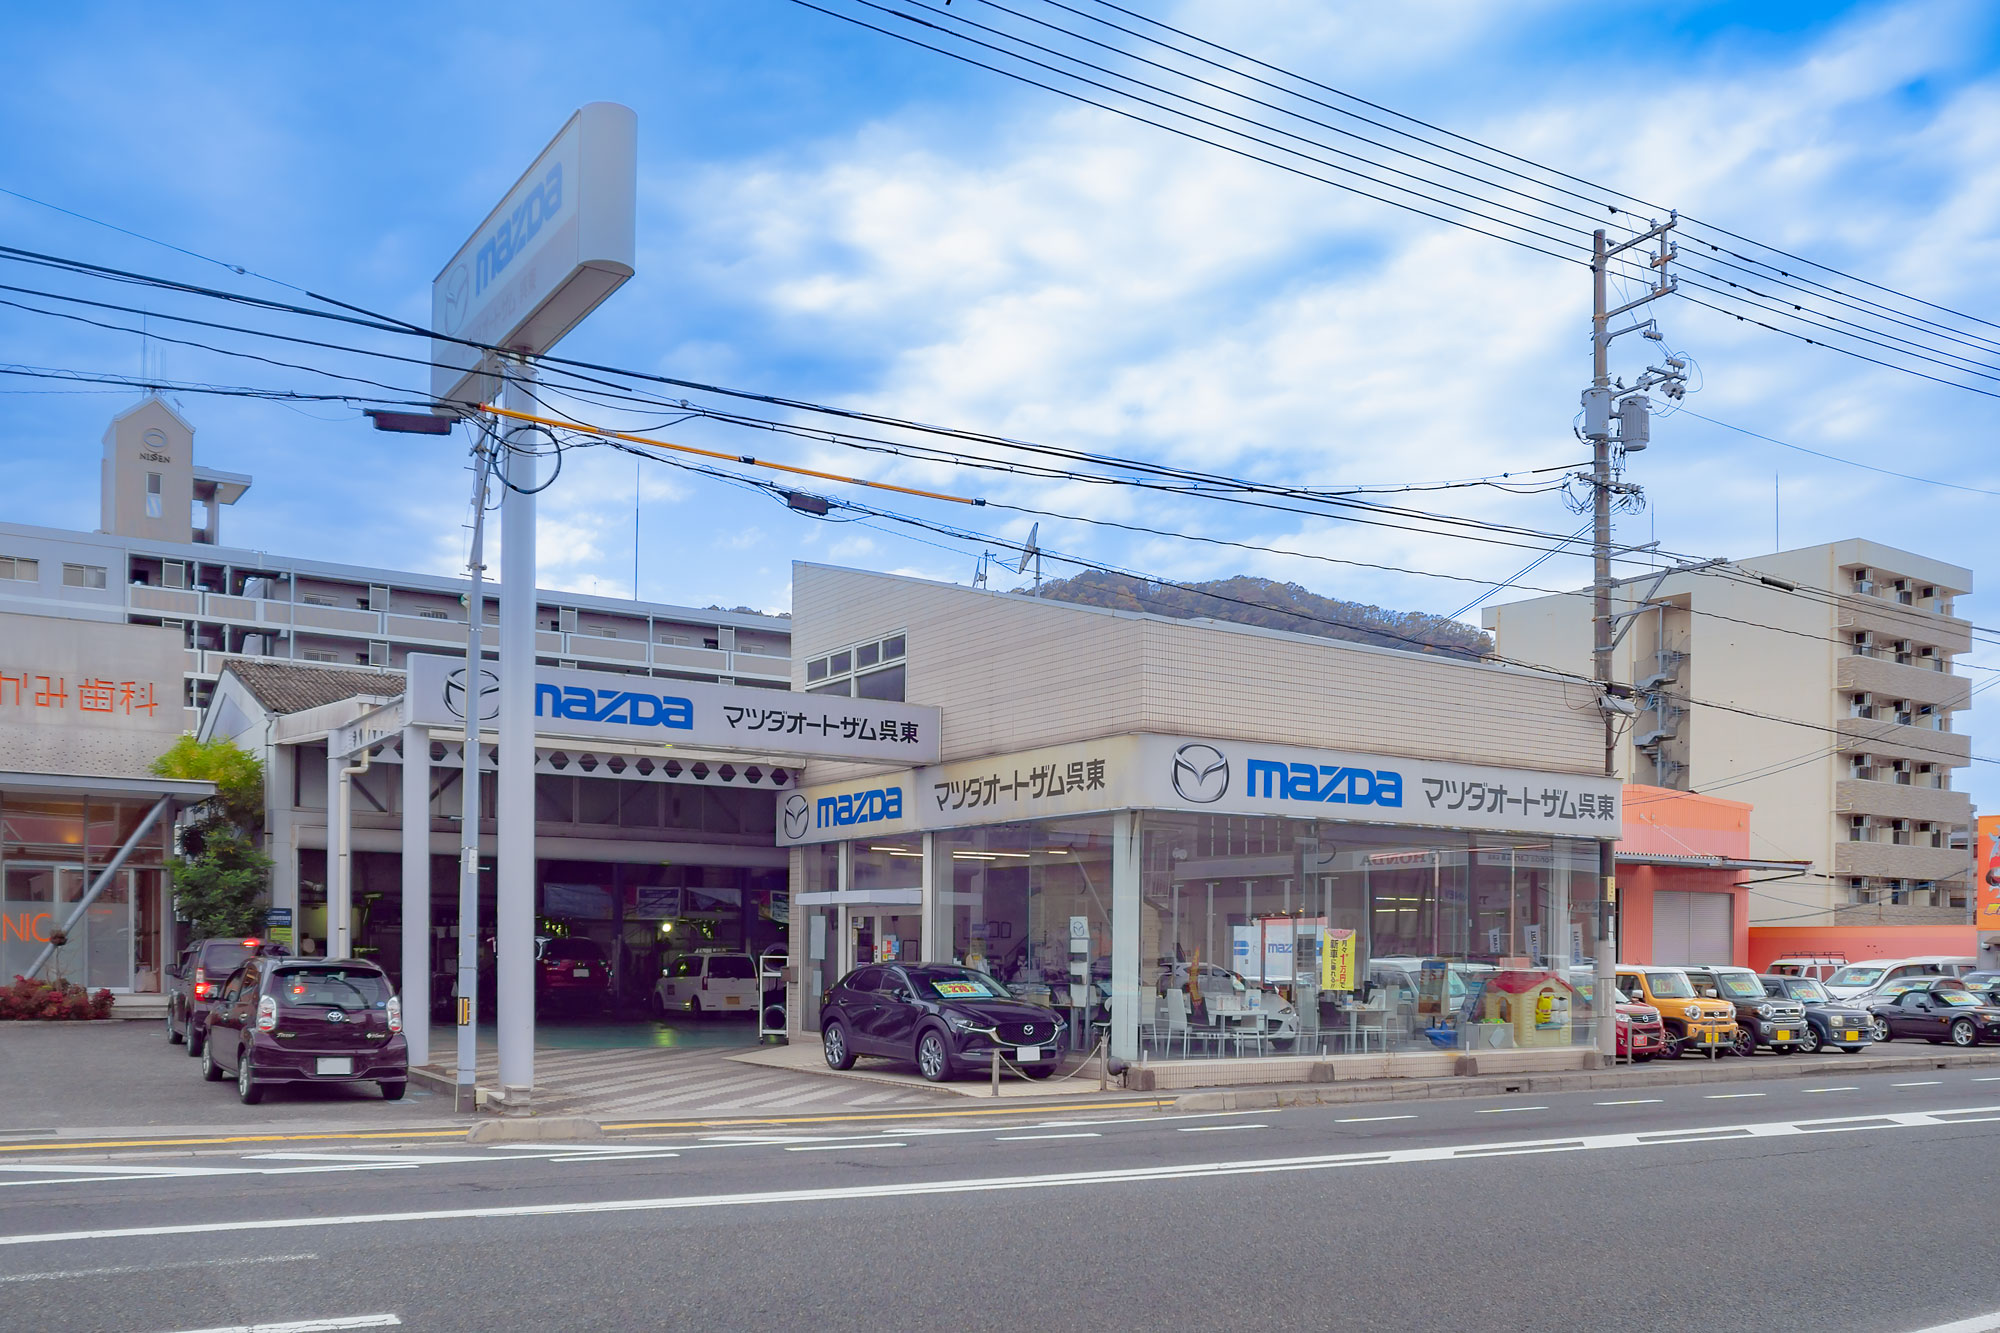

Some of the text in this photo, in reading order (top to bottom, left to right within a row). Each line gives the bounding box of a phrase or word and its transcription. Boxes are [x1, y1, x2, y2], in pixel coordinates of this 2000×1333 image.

[139, 453, 171, 463] NISSEN
[723, 705, 919, 745] マツダオートザム呉東
[934, 758, 1106, 812] マツダオートザム呉東
[1422, 778, 1615, 821] マツダオートザム呉東
